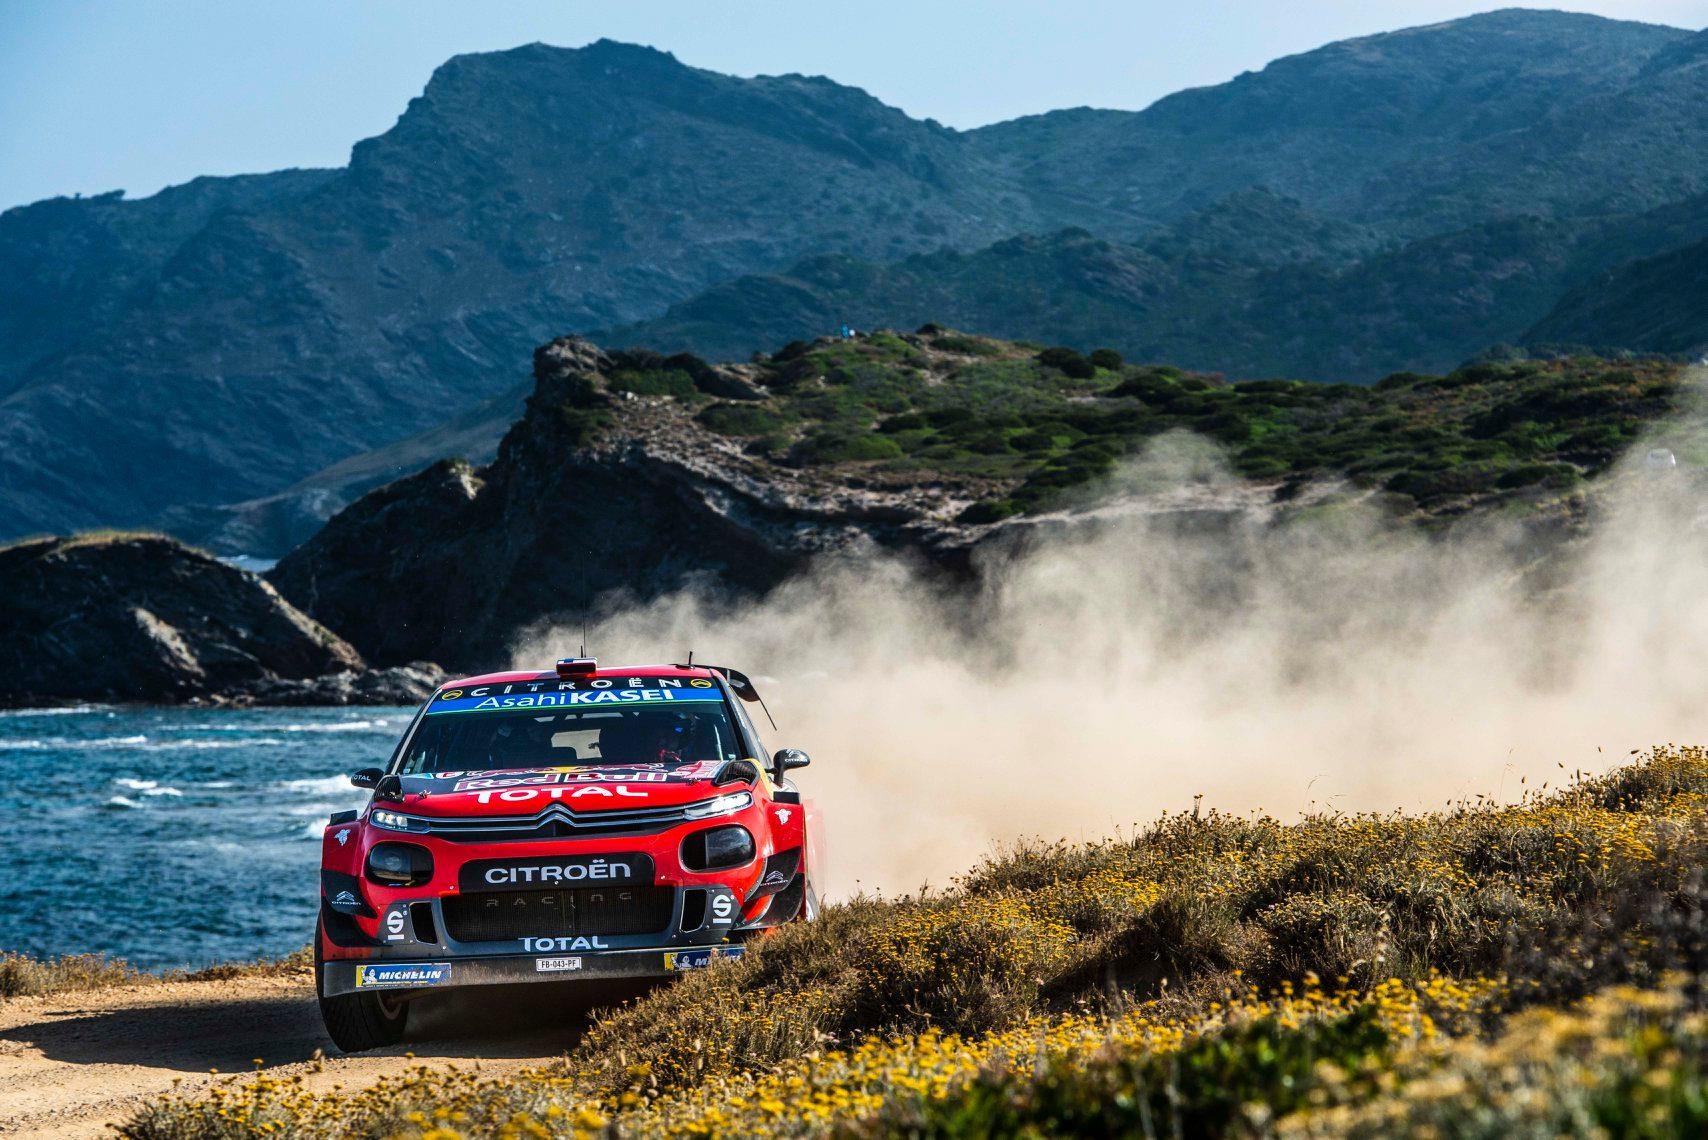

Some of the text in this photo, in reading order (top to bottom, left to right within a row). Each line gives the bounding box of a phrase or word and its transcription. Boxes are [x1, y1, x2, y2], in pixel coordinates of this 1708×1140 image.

[471, 677, 682, 697] CITROËN
[453, 771, 668, 792] Red Bull
[467, 785, 649, 804] TOTAL
[518, 935, 609, 952] TOTAL
[541, 959, 577, 969] FB-043-PF
[378, 970, 442, 980] MICHELIN
